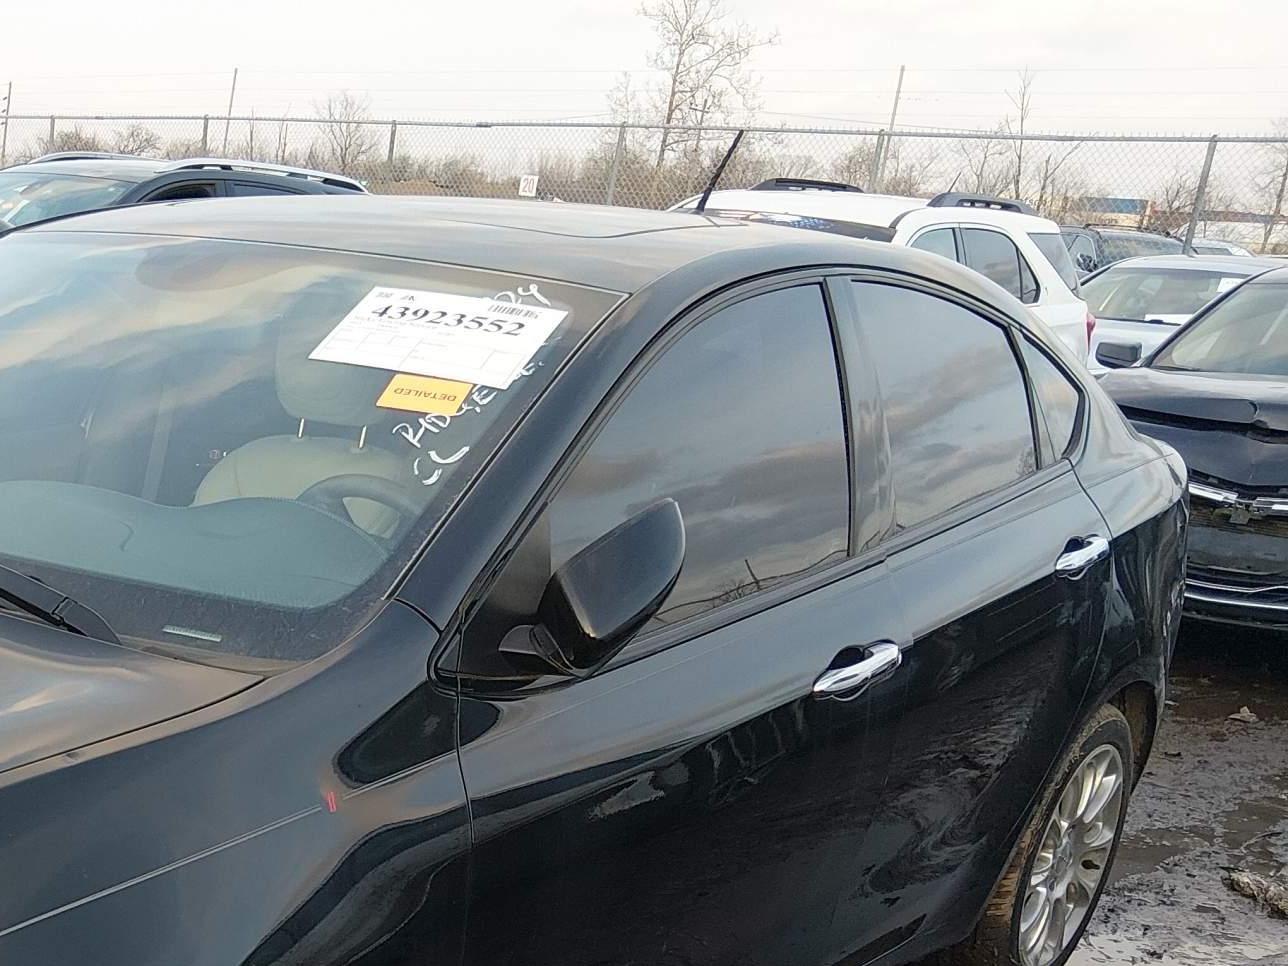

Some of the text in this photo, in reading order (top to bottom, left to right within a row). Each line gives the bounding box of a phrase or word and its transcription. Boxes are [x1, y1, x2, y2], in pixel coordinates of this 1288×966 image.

[523, 178, 535, 192] 20
[371, 303, 526, 337] 43923552
[393, 387, 458, 402] DETAILED
